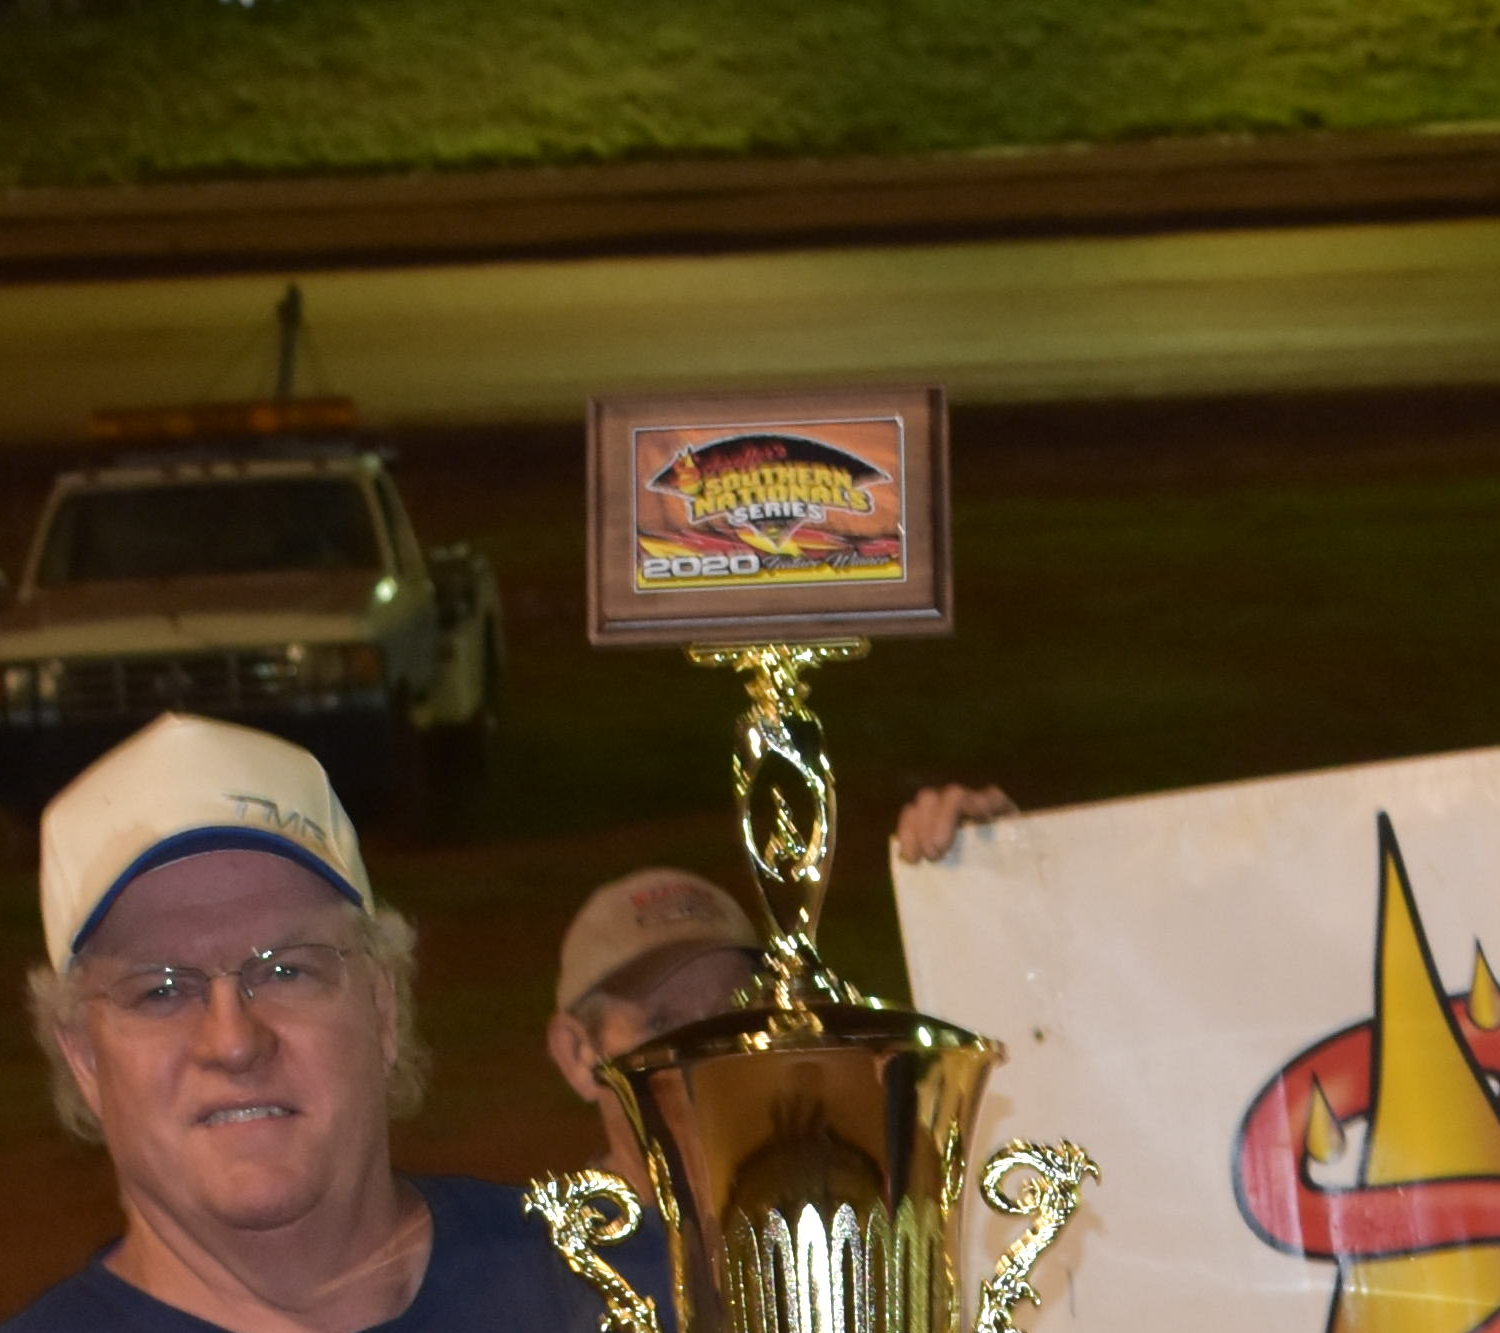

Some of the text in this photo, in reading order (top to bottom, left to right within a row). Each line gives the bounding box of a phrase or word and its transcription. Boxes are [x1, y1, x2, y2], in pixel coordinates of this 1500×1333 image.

[703, 461, 854, 492] SOUTHERN
[693, 484, 871, 517] NATIONALS
[731, 502, 823, 523] SERIES
[642, 553, 761, 578] 2020
